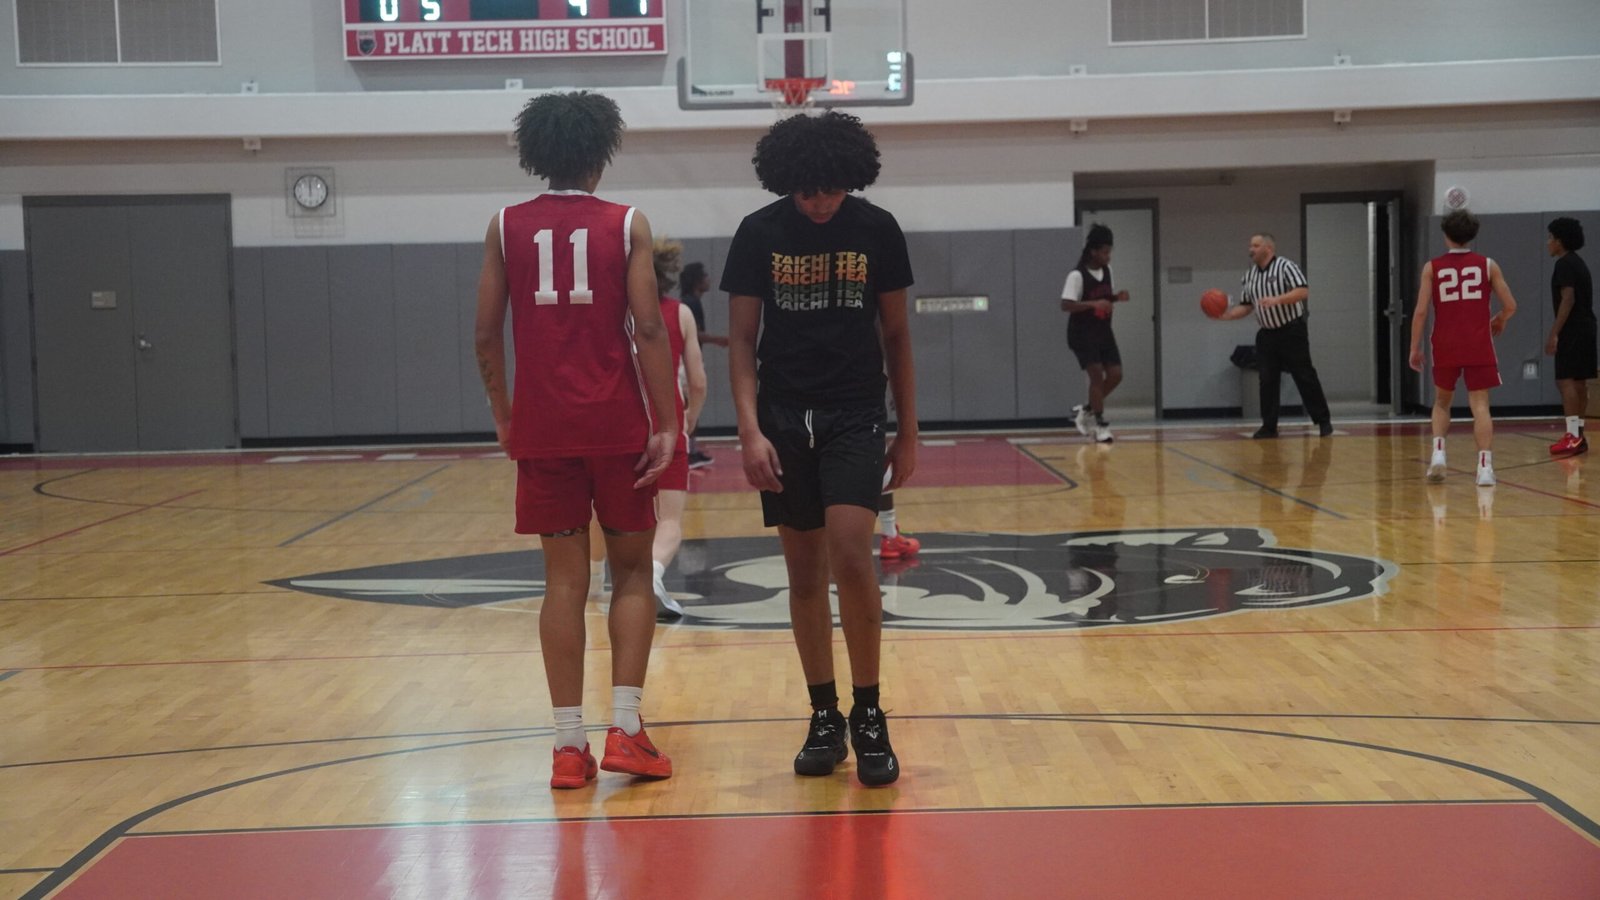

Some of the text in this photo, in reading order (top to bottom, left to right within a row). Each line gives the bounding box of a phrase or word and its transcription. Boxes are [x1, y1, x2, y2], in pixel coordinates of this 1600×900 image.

[384, 27, 655, 53] PLATT TECH HIGH SCHOOL
[534, 228, 593, 305] 11
[772, 252, 867, 265] TAICHI TEA
[772, 261, 867, 274] TAICHI TEA
[772, 270, 867, 285] TAICHI TEA
[1437, 265, 1482, 303] 22
